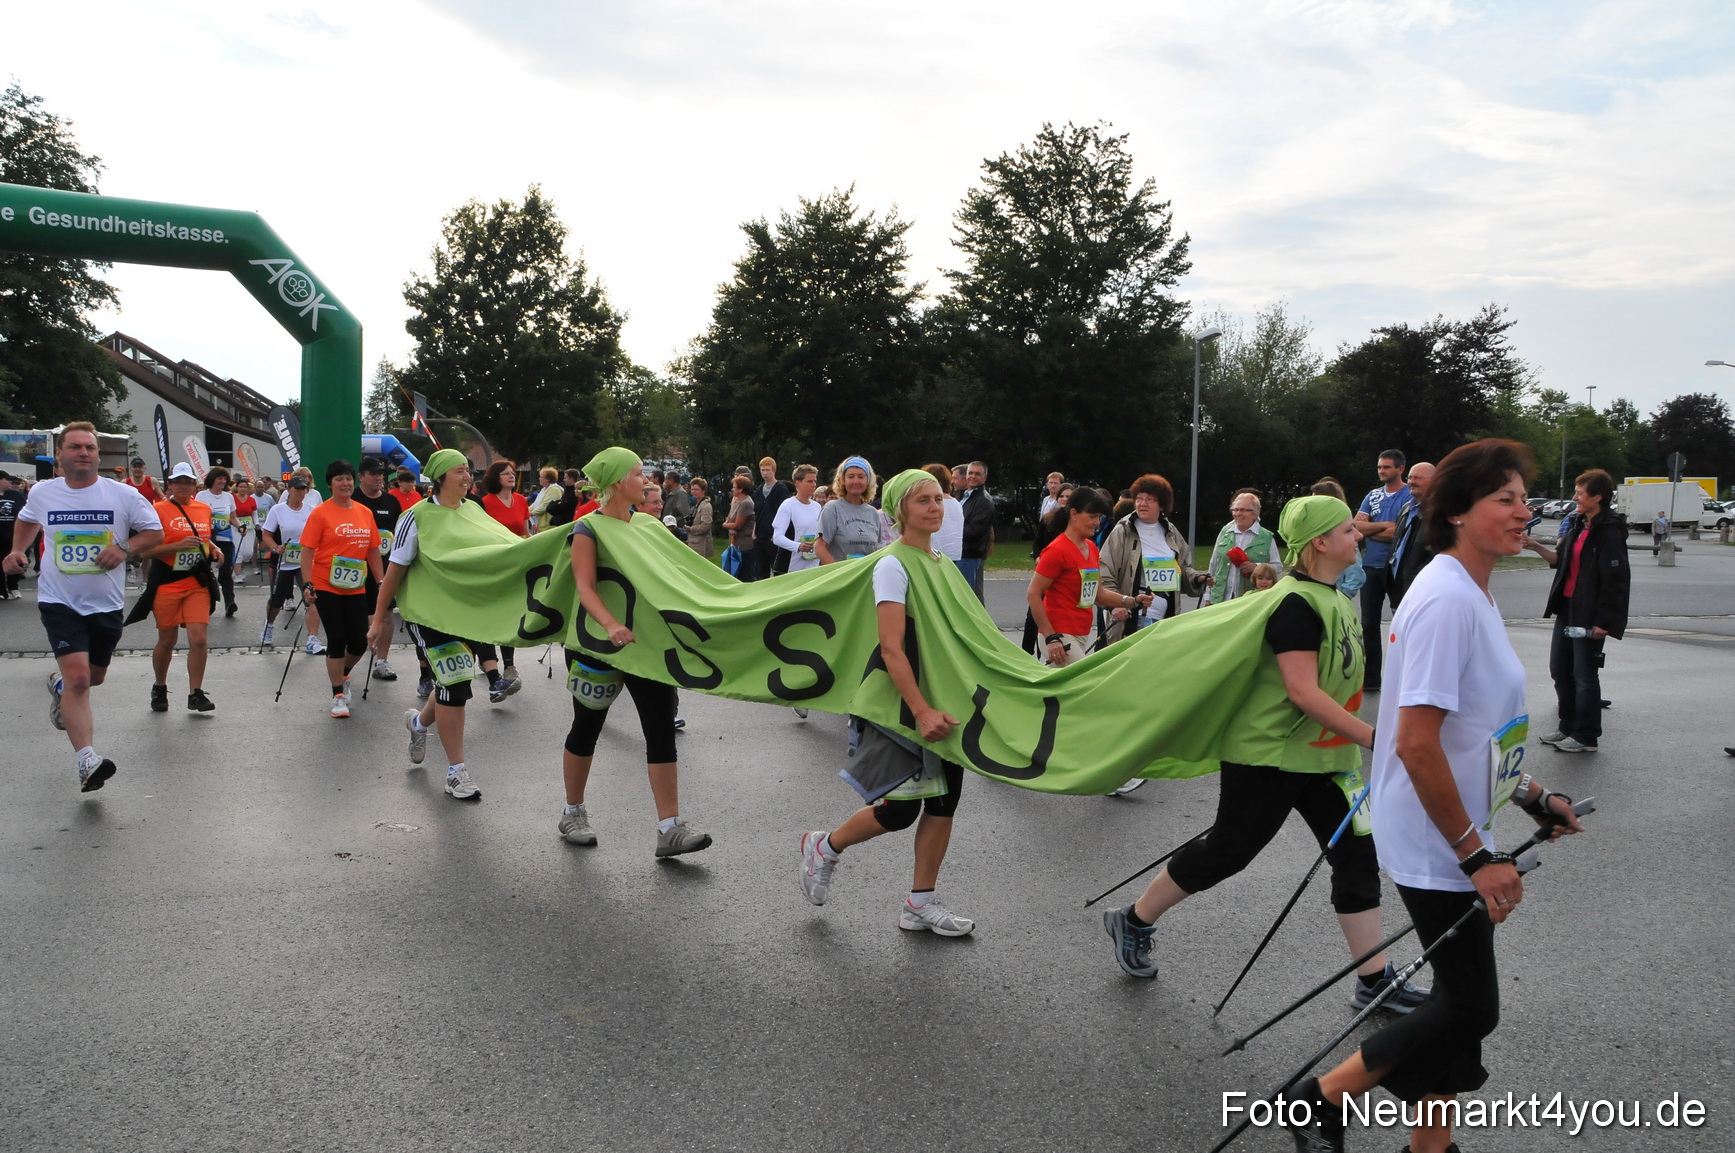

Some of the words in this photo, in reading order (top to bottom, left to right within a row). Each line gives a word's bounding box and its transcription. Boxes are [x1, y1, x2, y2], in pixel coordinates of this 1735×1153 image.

[28, 206, 229, 244] Gesundheitskasse.
[248, 259, 339, 332] AOK
[56, 514, 110, 522] STAEDTLER
[342, 527, 371, 535] Fischer
[61, 545, 102, 563] 893
[333, 567, 359, 582] 973
[1145, 569, 1175, 582] 1267
[1082, 581, 1097, 598] 637
[435, 654, 473, 675] 1098
[571, 677, 617, 699] 1099
